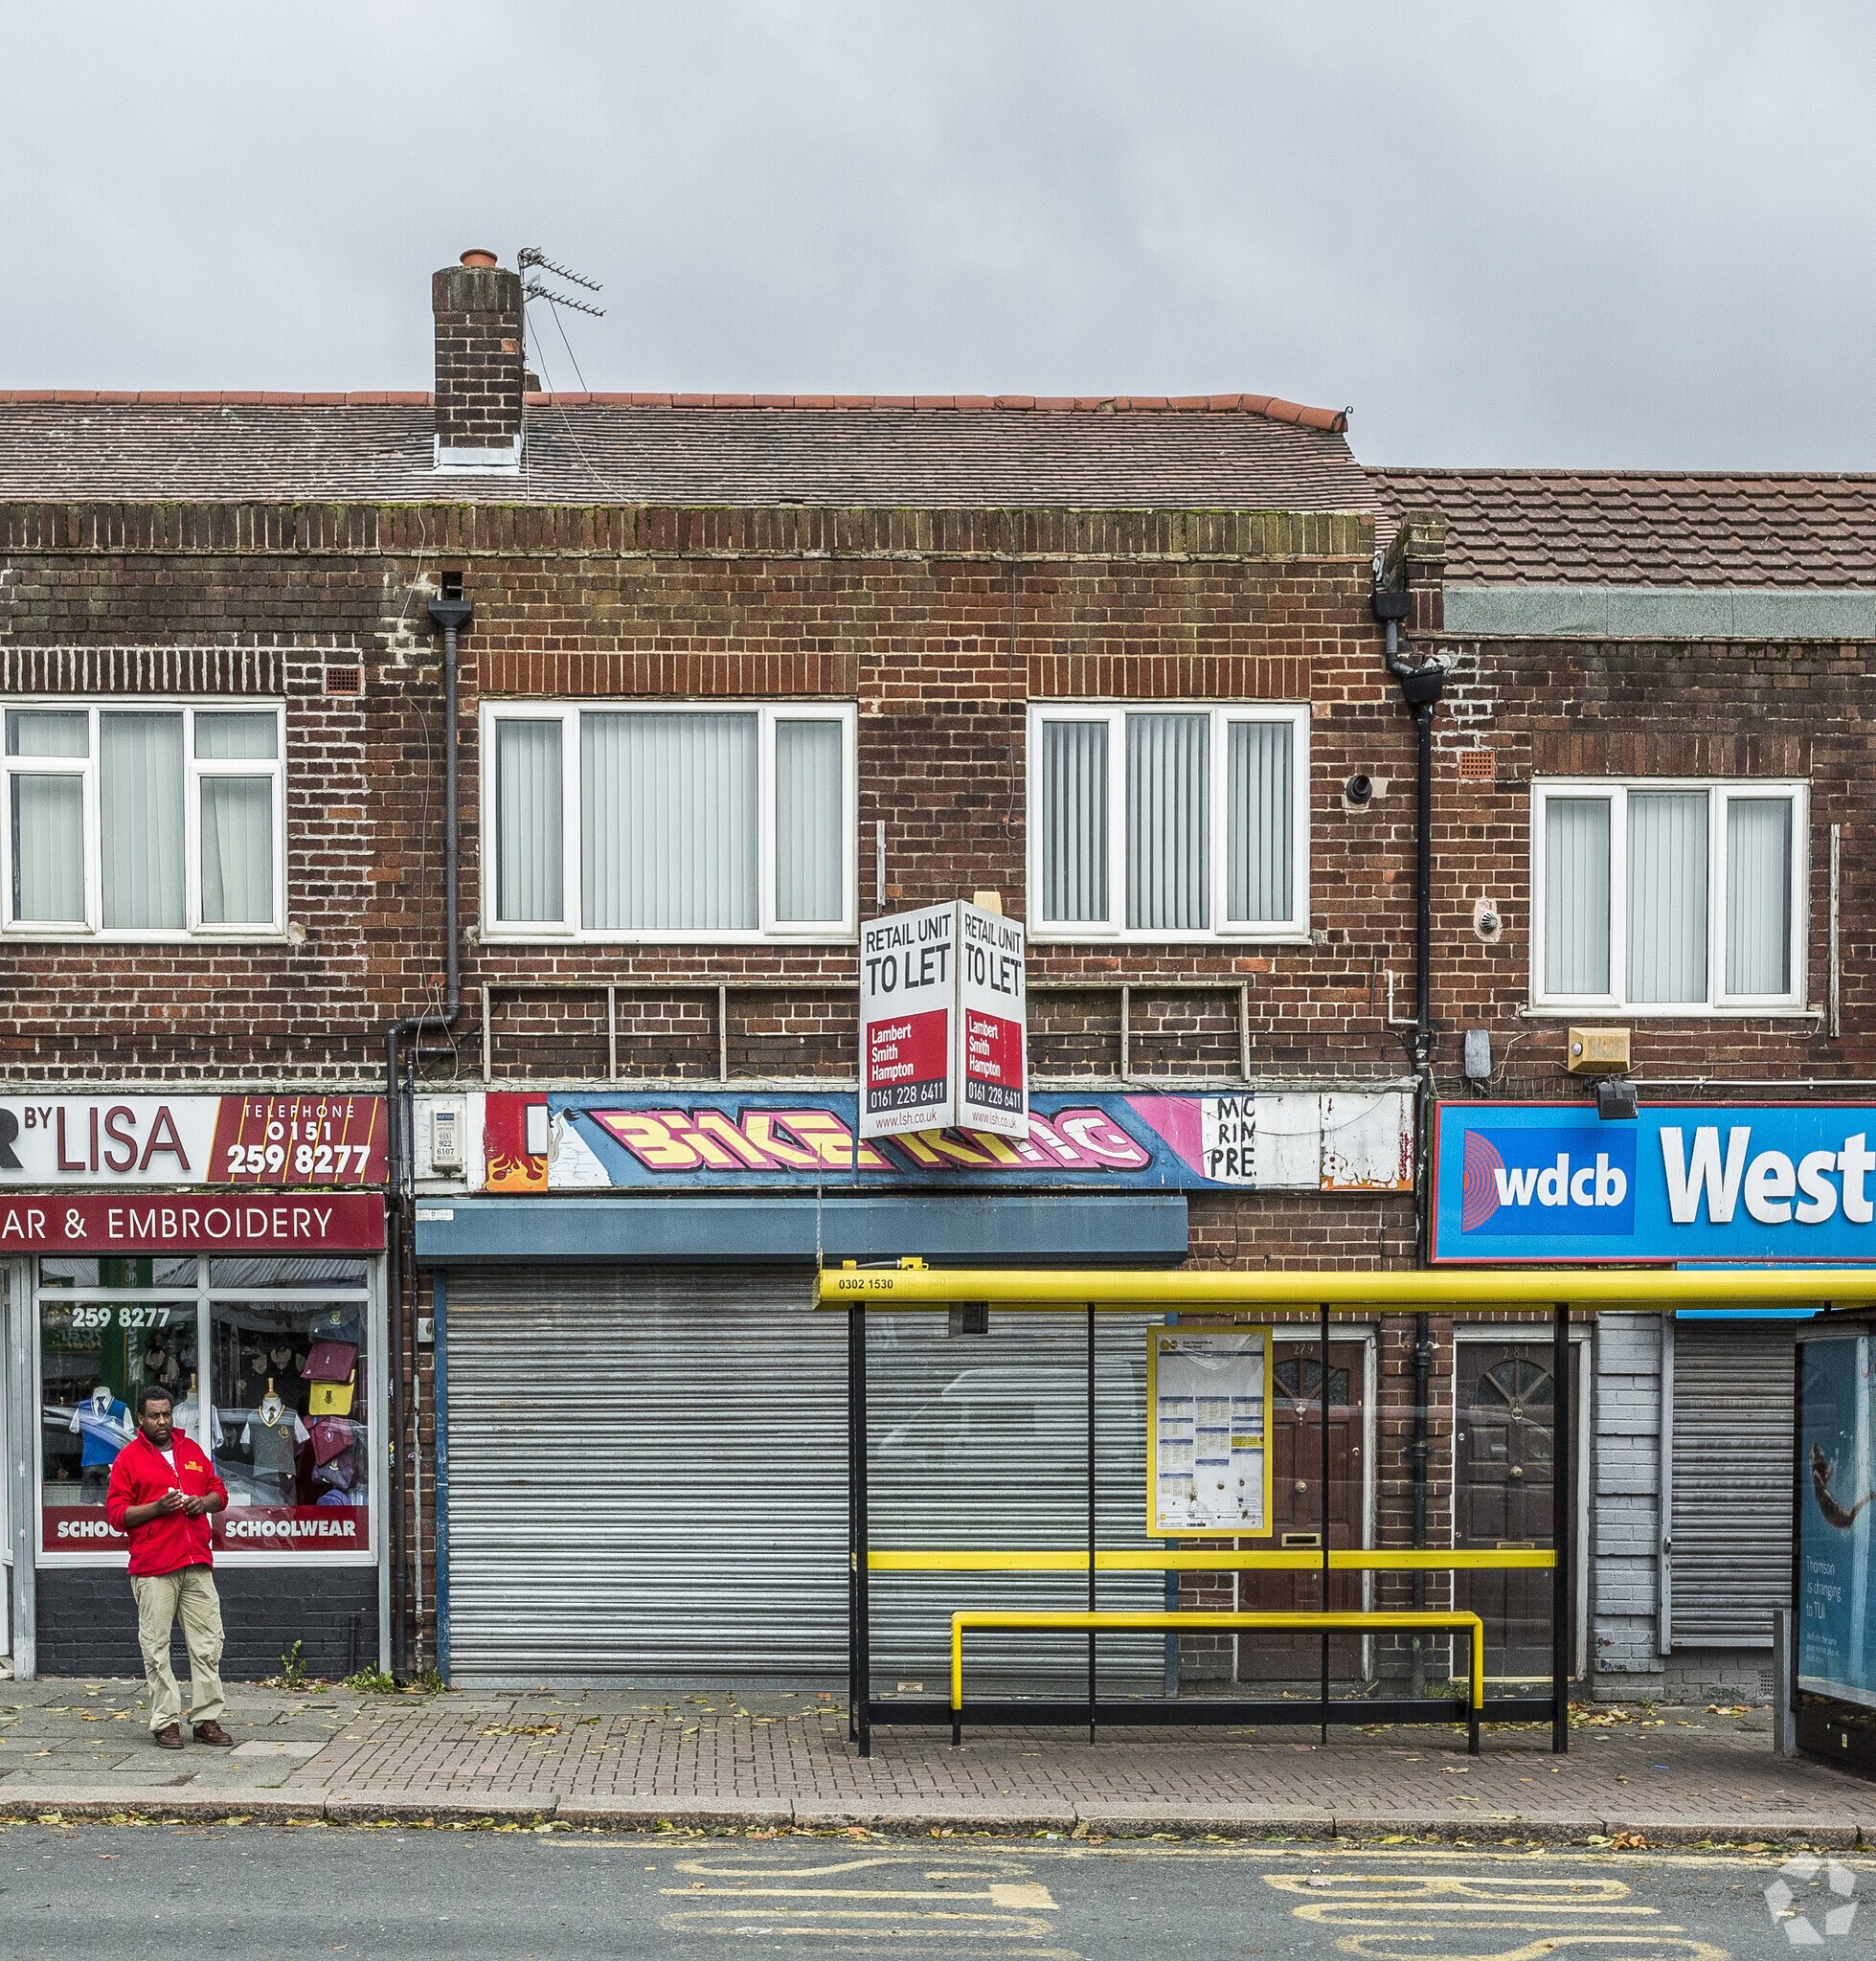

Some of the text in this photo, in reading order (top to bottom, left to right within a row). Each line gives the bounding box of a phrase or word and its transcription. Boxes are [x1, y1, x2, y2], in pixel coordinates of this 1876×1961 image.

[866, 913, 952, 954] RETAIL UNIT
[964, 913, 1022, 954] RETAIL UNIT
[866, 942, 951, 996] TO LET
[965, 942, 1022, 997] TO LET
[871, 1023, 912, 1045] Lambert
[968, 1015, 999, 1039] Lambert
[871, 1045, 898, 1064] Smith
[968, 1038, 990, 1057] Smith
[871, 1061, 915, 1082] Hampton
[969, 1056, 1001, 1078] Hampton
[870, 1081, 943, 1109] 0161 228 6411
[968, 1082, 1021, 1109] 0161 228 6411
[244, 1104, 355, 1118] TELEPHONE
[876, 1108, 937, 1129] www.lsh.co.uk
[971, 1109, 1017, 1130] www.lsh.co.uk
[24, 1106, 52, 1129] BY
[57, 1105, 192, 1172] LISA
[267, 1121, 332, 1141] 0151
[227, 1144, 371, 1174] 259 8277
[1494, 1126, 1876, 1225] wdcb West
[1, 1208, 333, 1239] AR & EMBROIDERY
[838, 1279, 865, 1290] 0302
[868, 1279, 893, 1290] 1530
[72, 1307, 170, 1327] 259 8277
[1293, 1343, 1313, 1355] 279
[1503, 1345, 1529, 1359] 281
[57, 1521, 356, 1538] SCHO SCHOOLWEAR
[1806, 1555, 1835, 1576] Thomson
[1807, 1577, 1841, 1603] is changing
[1806, 1601, 1825, 1619] to TUI
